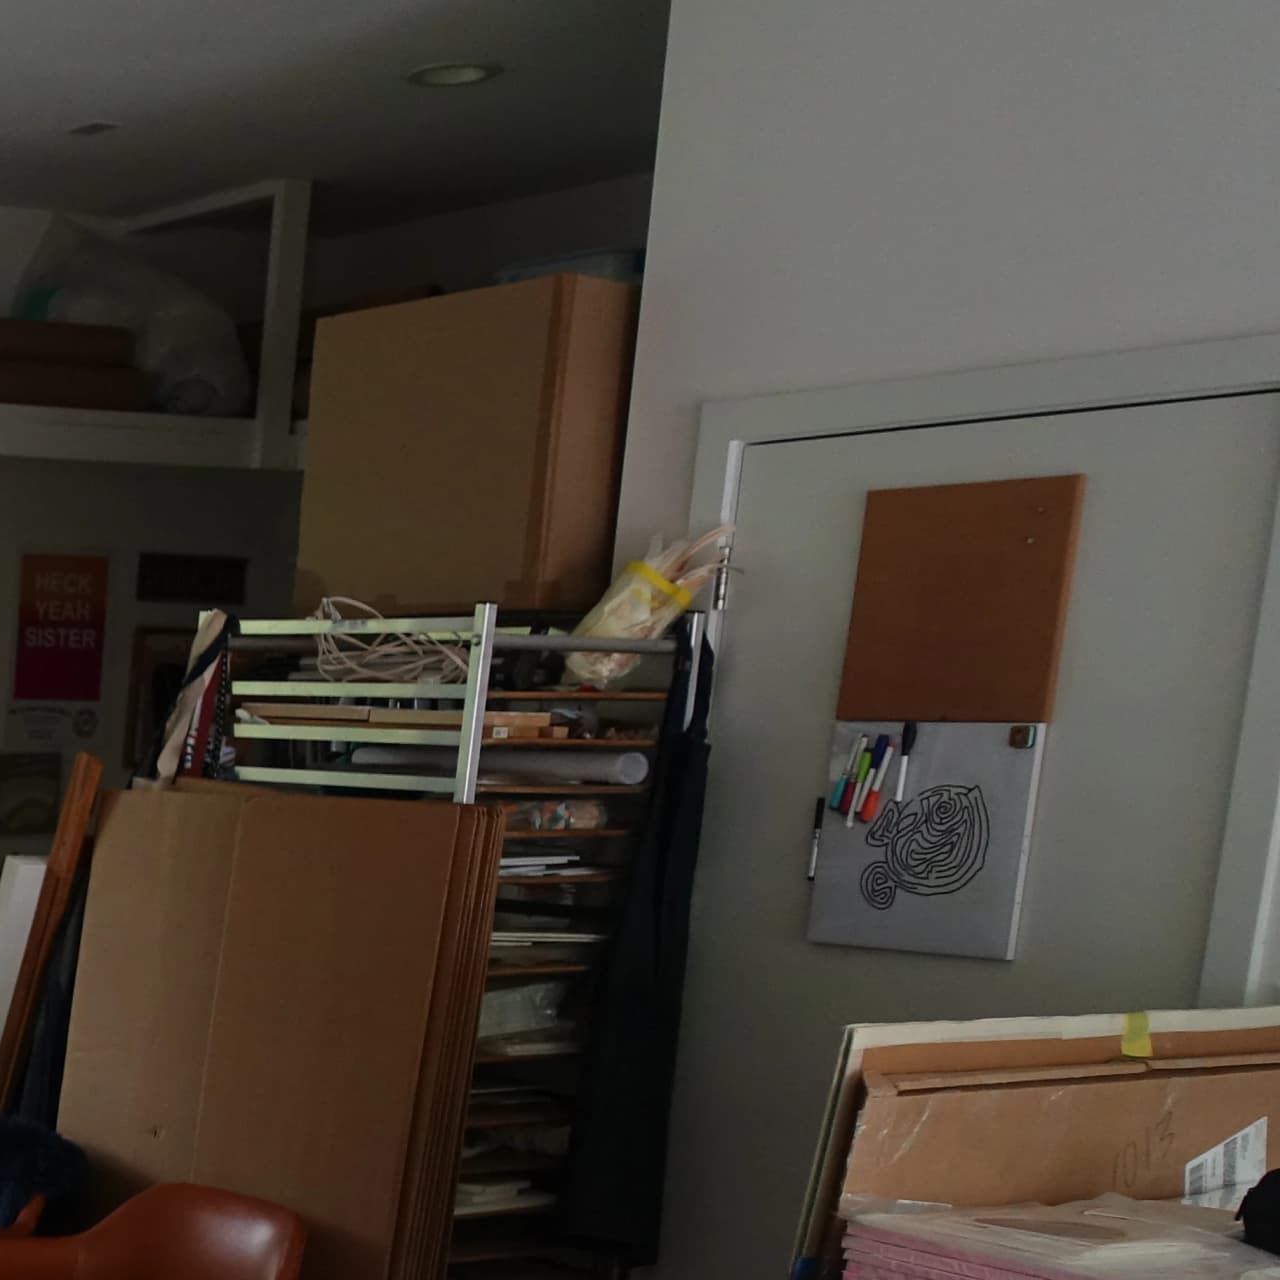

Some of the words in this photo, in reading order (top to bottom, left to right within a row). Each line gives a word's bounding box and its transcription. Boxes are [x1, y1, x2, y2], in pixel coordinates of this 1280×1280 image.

[34, 569, 92, 594] HECK
[35, 599, 91, 622] YEAH
[24, 626, 97, 649] SISTER
